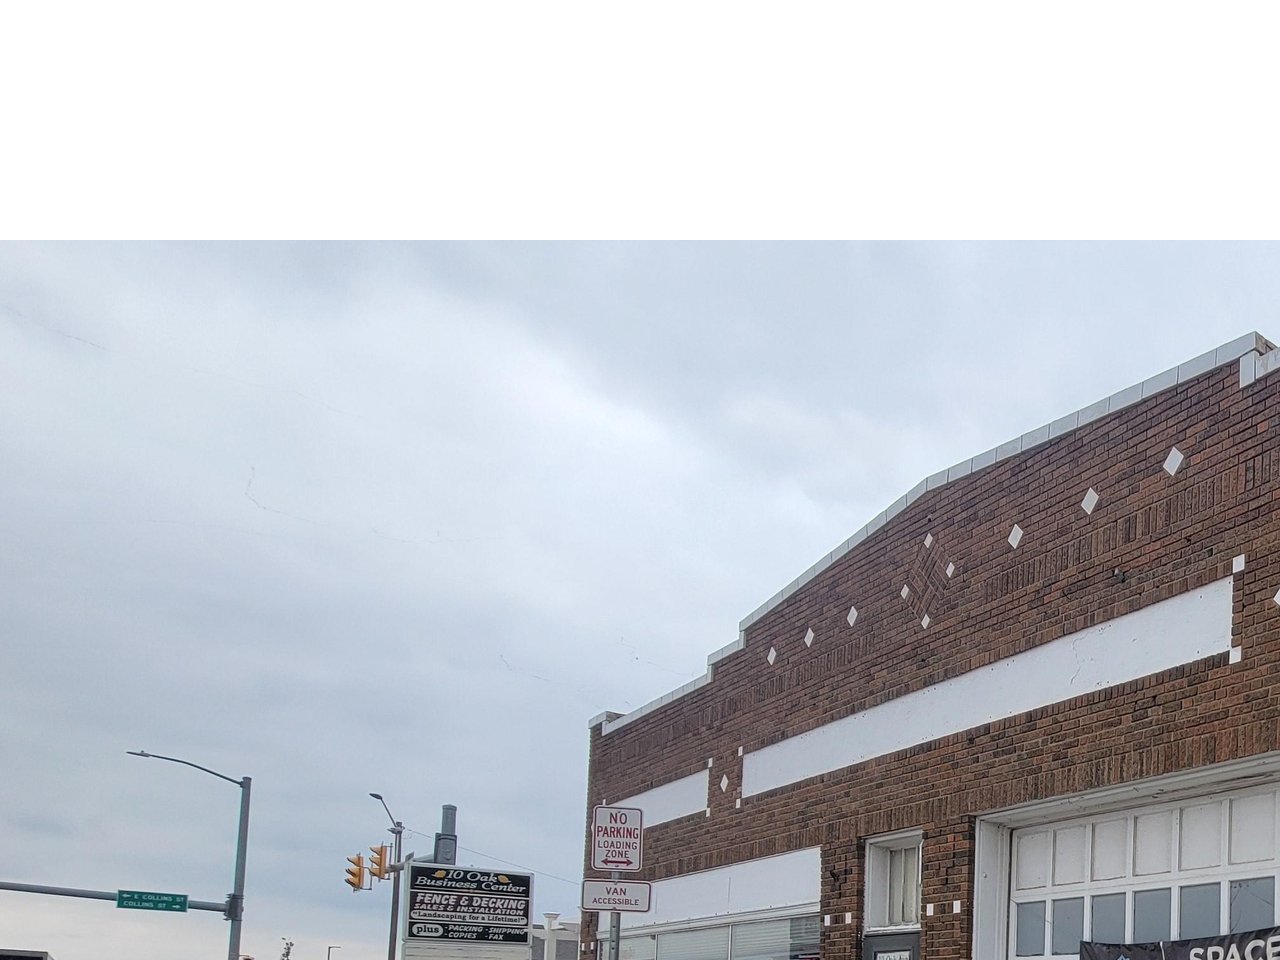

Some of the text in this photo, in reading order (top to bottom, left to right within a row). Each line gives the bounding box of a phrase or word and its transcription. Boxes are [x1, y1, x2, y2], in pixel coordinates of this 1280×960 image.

[609, 812, 628, 825] NO
[596, 825, 639, 839] PARKING
[597, 840, 638, 850] LOADING
[604, 849, 630, 859] ZONE
[446, 870, 498, 883] 10 Oak
[415, 876, 526, 893] Business Center
[605, 886, 627, 896] VAN
[142, 894, 173, 902] COLLINS
[415, 893, 526, 910] FENCE & DECKING
[591, 897, 640, 906] ACCESSIBLE
[413, 903, 445, 911] SALES
[456, 905, 524, 916] INSTALLATION
[416, 924, 440, 934] plus
